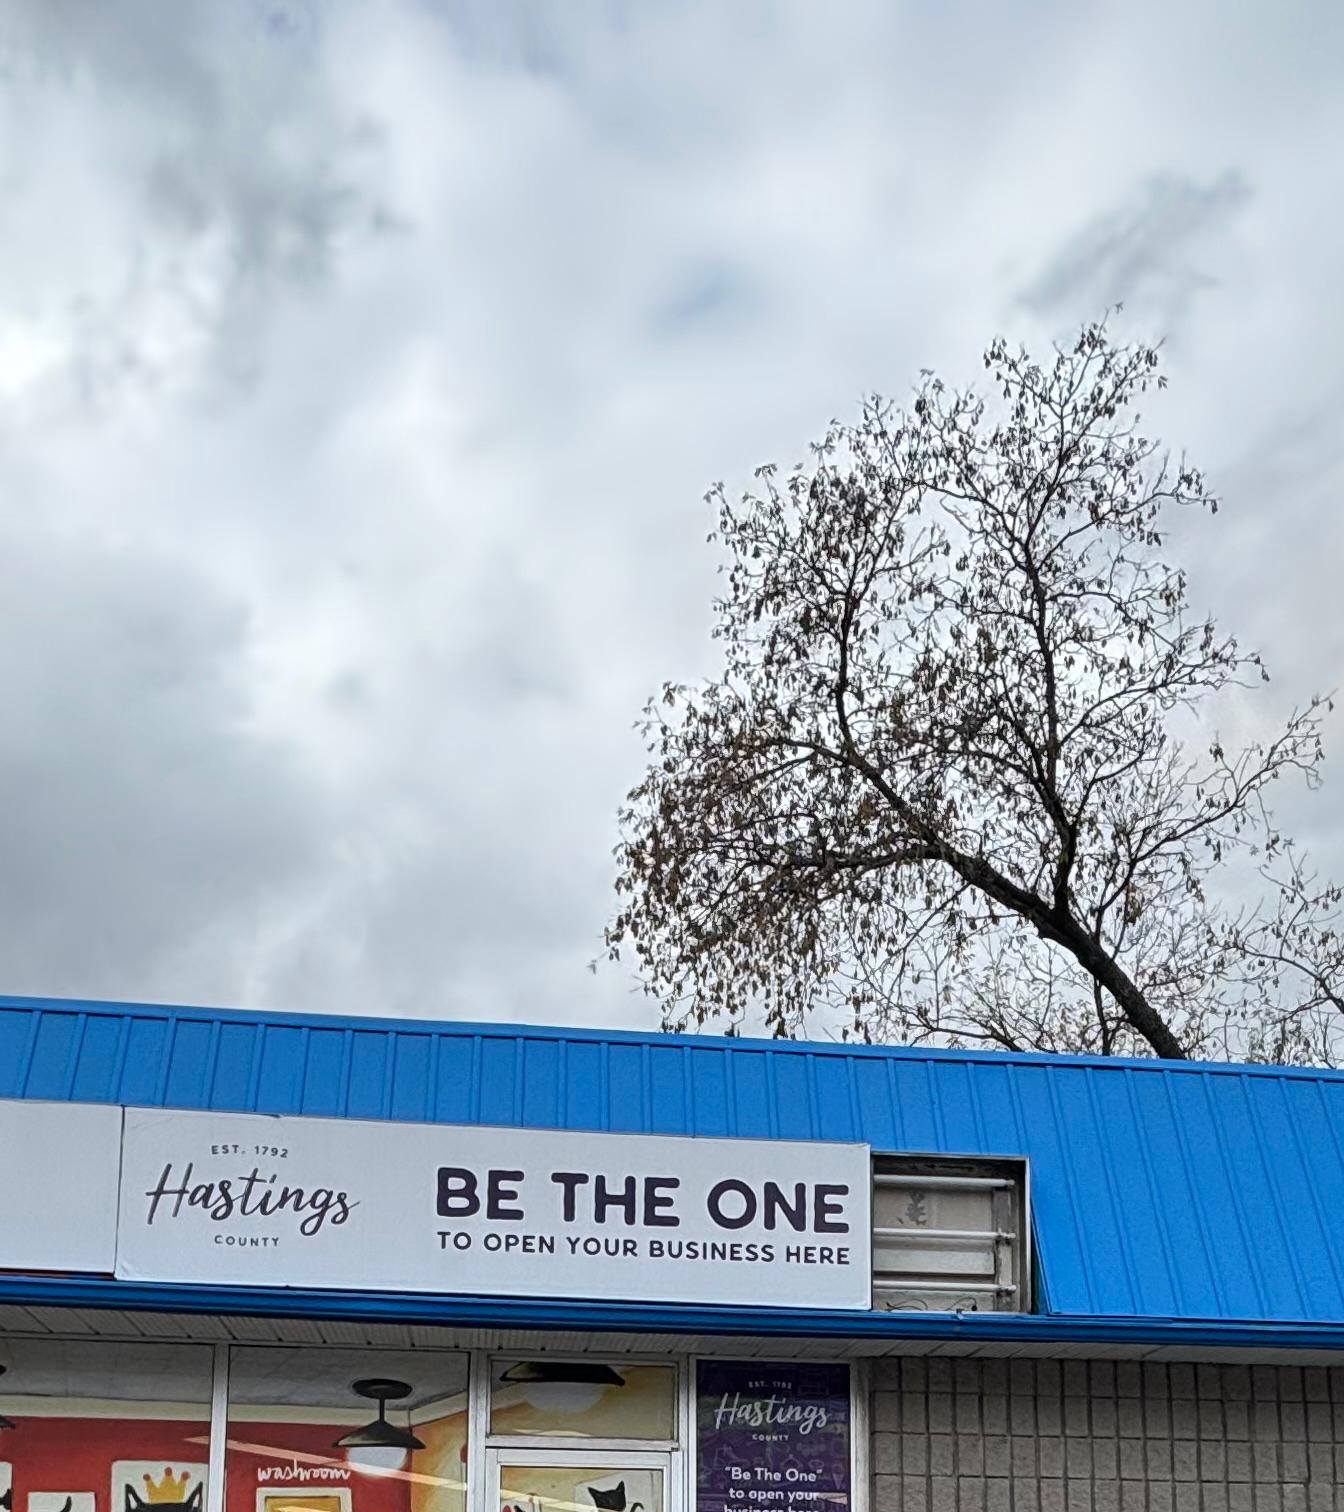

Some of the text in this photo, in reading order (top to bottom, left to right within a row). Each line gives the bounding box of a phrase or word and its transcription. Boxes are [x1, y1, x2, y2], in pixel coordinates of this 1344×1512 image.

[211, 1144, 289, 1159] EST. 1792
[145, 1162, 361, 1236] Hastings
[437, 1167, 850, 1234] BE THE ONE
[214, 1234, 281, 1247] COUNTY
[437, 1231, 850, 1265] TO OPEN YOUR BUSINESS HERE
[714, 1391, 832, 1435] Hastings
[752, 1433, 790, 1442] COUNTY
[257, 1459, 351, 1482] washroom
[754, 1467, 782, 1481] The
[729, 1487, 819, 1503] to open your
